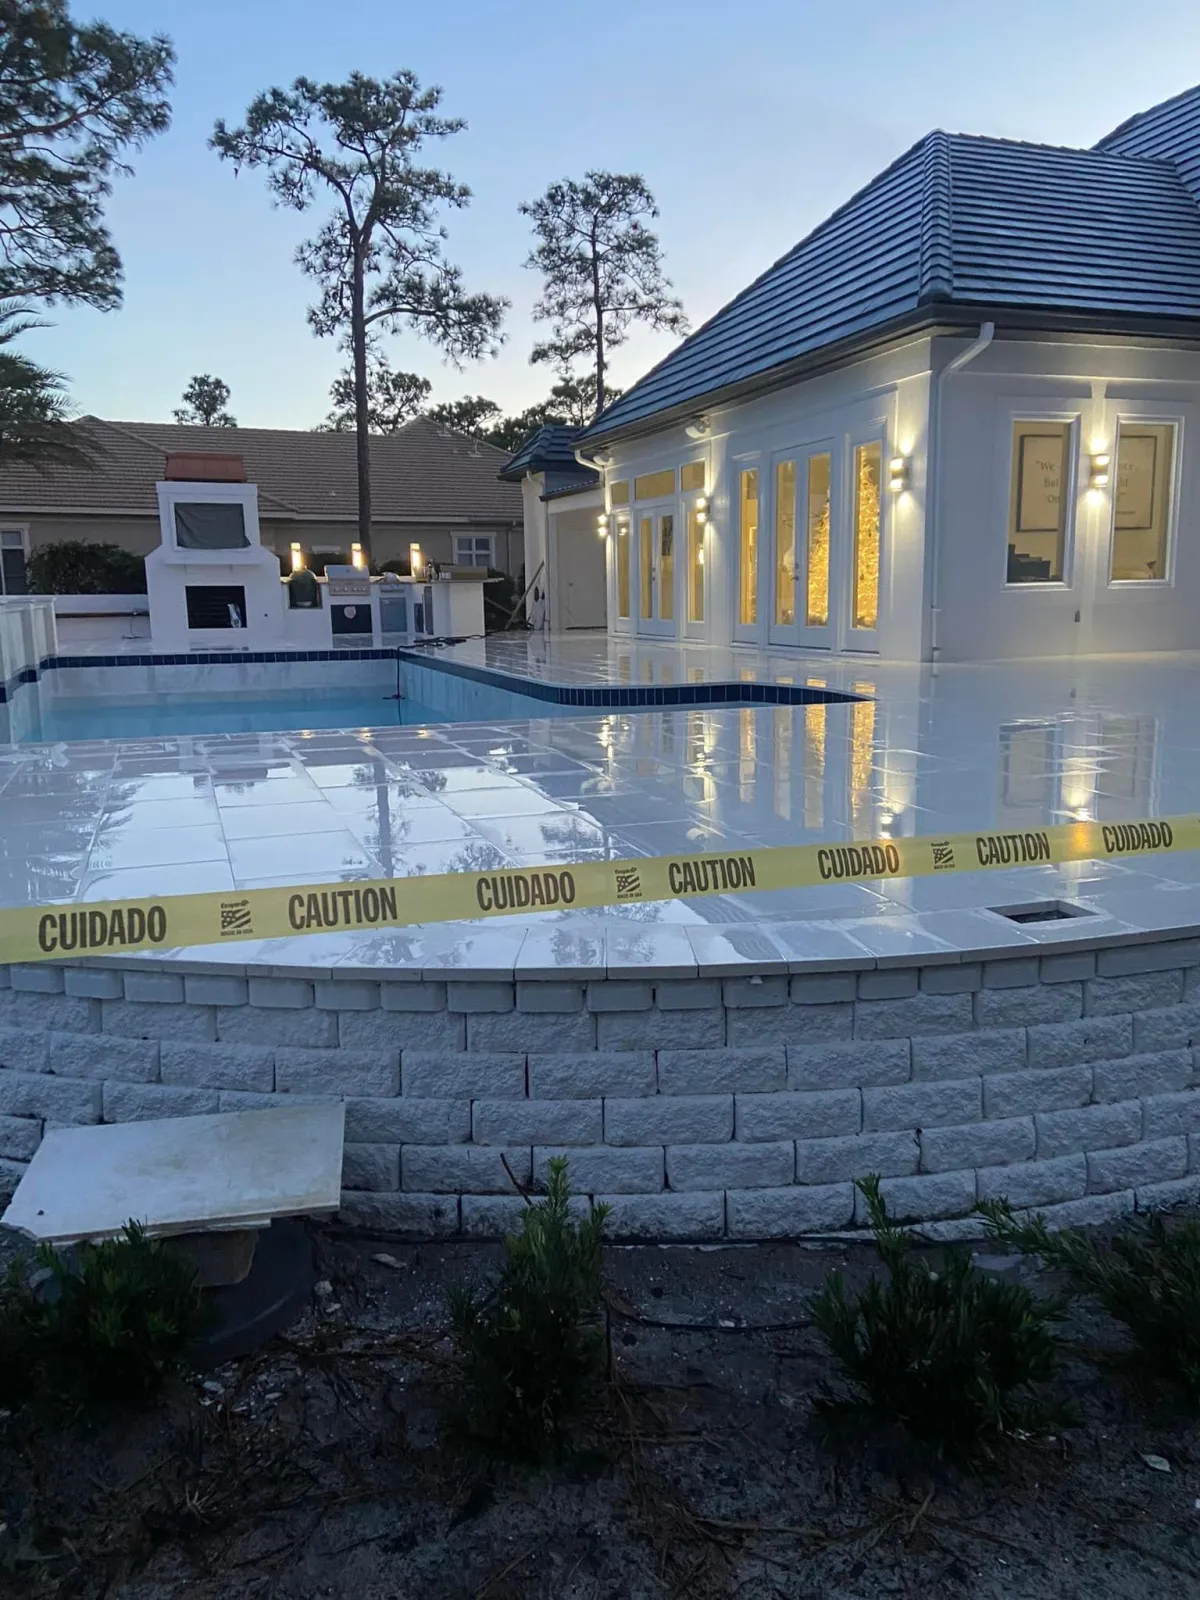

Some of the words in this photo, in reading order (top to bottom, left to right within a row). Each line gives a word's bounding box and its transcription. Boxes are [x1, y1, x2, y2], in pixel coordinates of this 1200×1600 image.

[975, 832, 1051, 866] CAUTION
[1102, 821, 1173, 853] CUIDADO
[668, 856, 756, 894] CAUTION
[817, 845, 900, 880] CUIDADO
[288, 886, 398, 930] CAUTION
[476, 871, 576, 911] CUIDADO
[38, 905, 167, 953] CUIDADO
